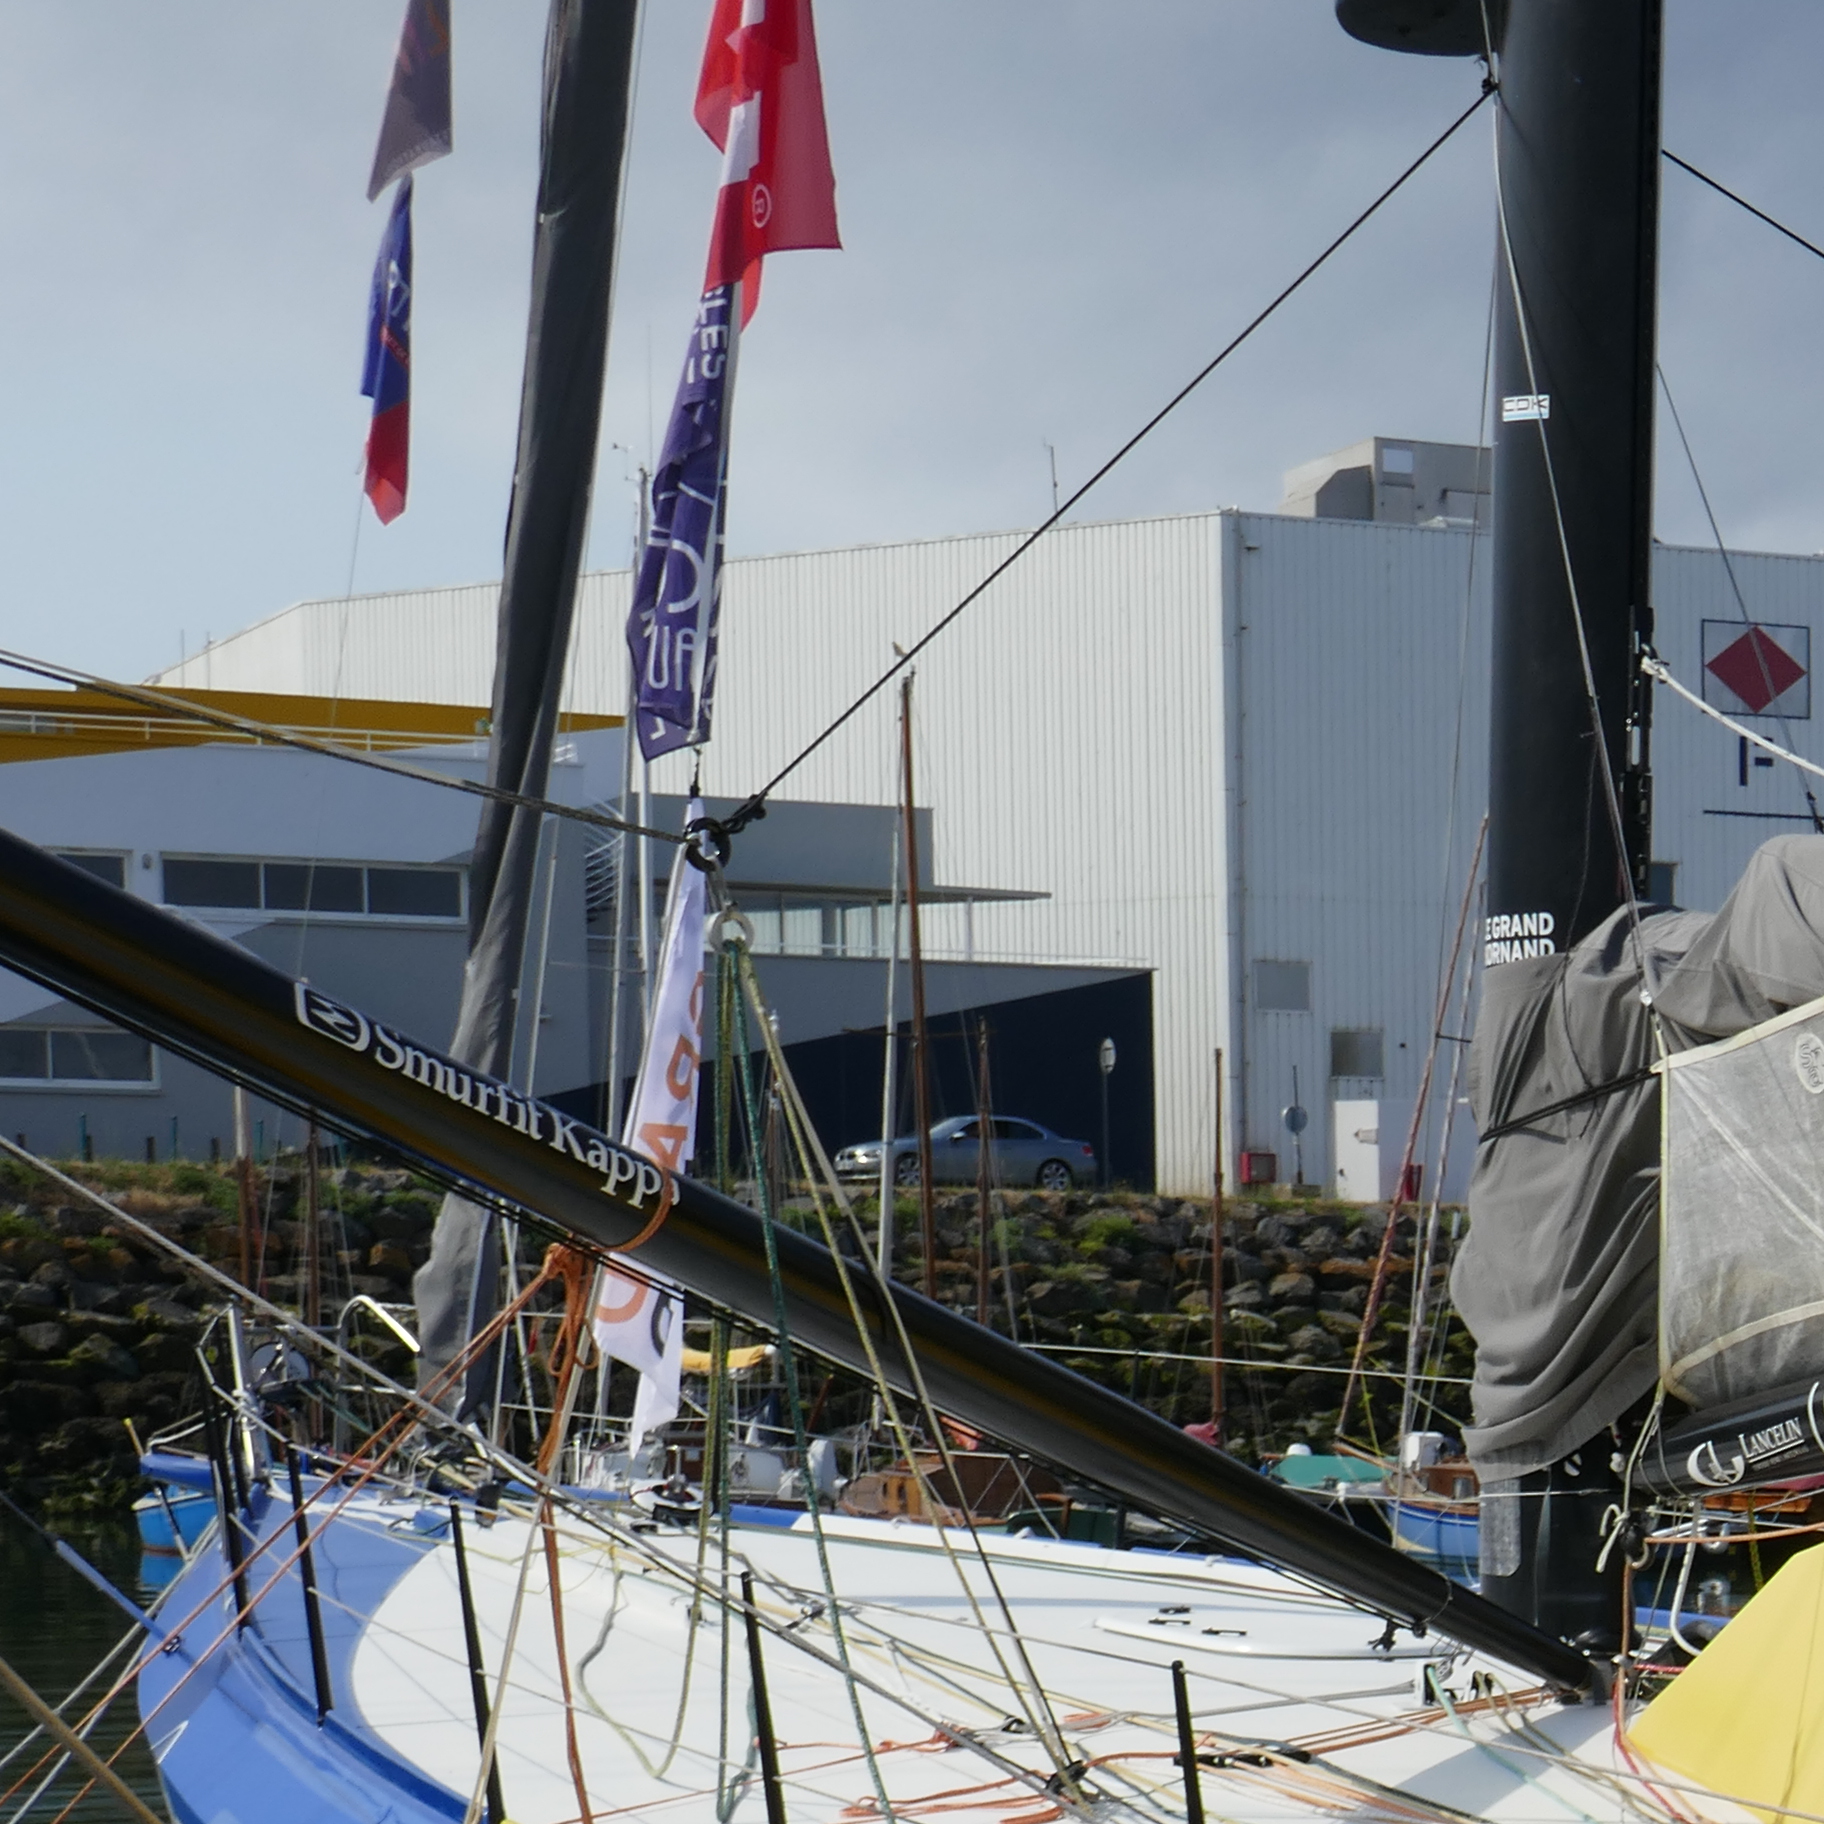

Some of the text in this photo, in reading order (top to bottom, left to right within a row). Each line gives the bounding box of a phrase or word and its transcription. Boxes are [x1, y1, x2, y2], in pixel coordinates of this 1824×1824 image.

[1491, 911, 1555, 940] GRAND
[374, 1025, 544, 1141] Smurfit
[1738, 1416, 1804, 1459] LANCELIN
